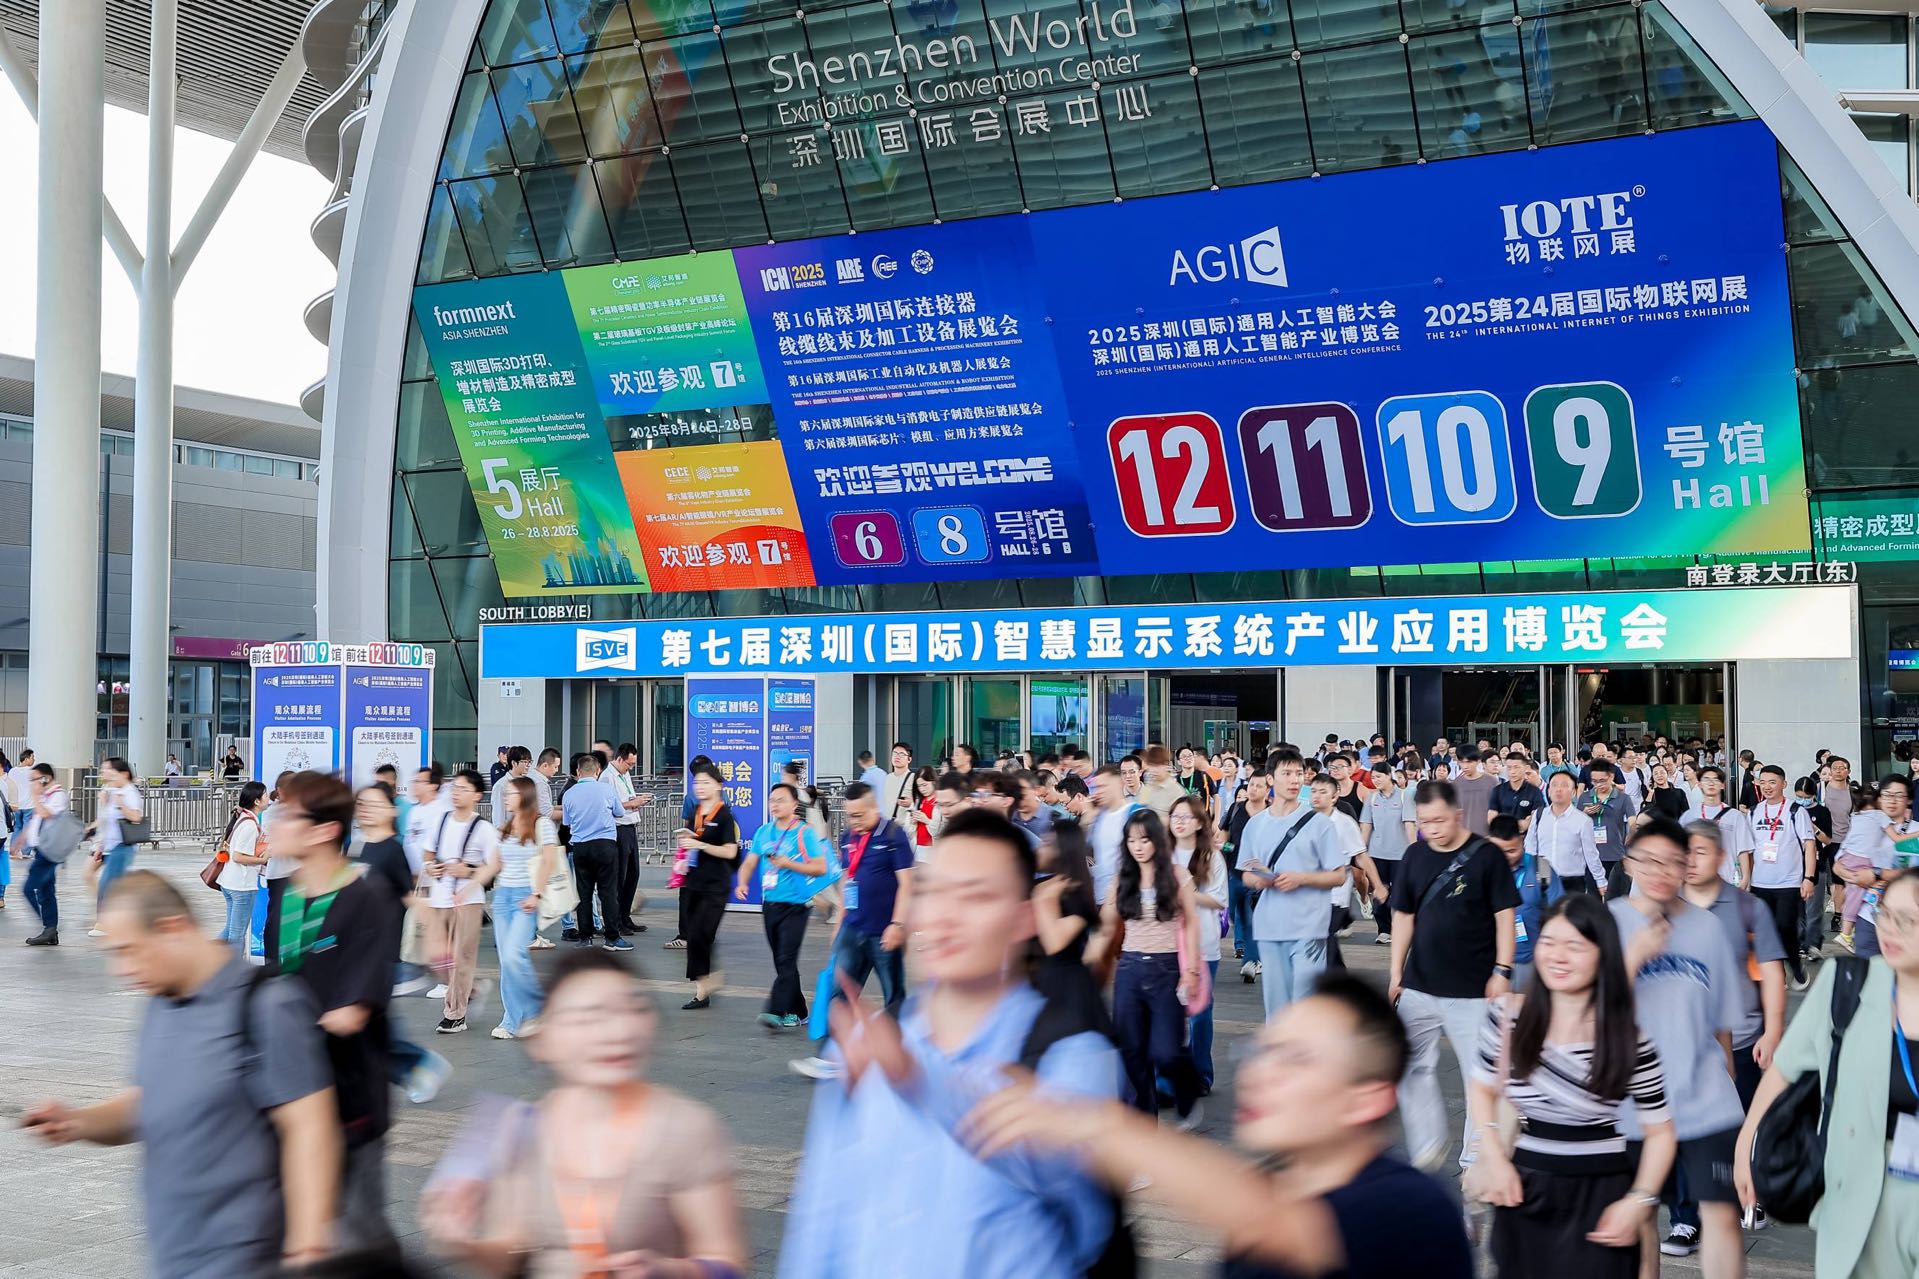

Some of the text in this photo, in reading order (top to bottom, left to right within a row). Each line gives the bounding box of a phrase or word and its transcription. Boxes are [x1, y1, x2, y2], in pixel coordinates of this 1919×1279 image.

[768, 1, 1137, 94] Shenzhen World
[777, 51, 1142, 127] Exhibition & Convention Center
[785, 85, 1151, 168] 深圳国际会展中心
[1499, 191, 1633, 241] IOTE
[1169, 225, 1288, 288] AGIC
[1506, 230, 1636, 265] 物联网展
[760, 267, 790, 292] ICH
[792, 264, 824, 281] 2025
[795, 280, 826, 288] SHENZHEN
[433, 300, 516, 326] formnext
[773, 291, 976, 333] 第16届深圳国际连接器
[1424, 275, 1747, 327] 2025第24届国际物联网展
[442, 325, 508, 341] ASIA SHENZHEN
[778, 314, 1019, 357] 线缆线束及加工设备展览会
[1088, 301, 1396, 345] 2025深圳(国际)通用人工智能大会
[1426, 332, 1445, 340] THE
[1475, 322, 1558, 336] INTERNATIONAL
[1563, 317, 1616, 329] INTERNET
[1621, 314, 1633, 323] OF
[1638, 311, 1679, 321] THINGS
[1684, 305, 1750, 318] EXHIBITION
[1092, 323, 1399, 366] 深圳(国际)通用人工智能产业博览会
[451, 353, 552, 376] 深圳国际3D打印、
[1154, 361, 1214, 372] (INTERNATIONAL)
[1218, 358, 1256, 366] ARTIFICIAL
[1295, 350, 1348, 359] INTELLIGENCE
[1351, 345, 1401, 354] CONFERENCE
[457, 370, 576, 395] 增材制造及精密成型
[609, 365, 705, 396] 欢迎参观
[716, 364, 728, 384] 7
[788, 356, 1011, 388] 第16届深圳国际工业自动化及机器人展览会
[463, 397, 501, 413] 展览会
[799, 402, 1043, 432] 第六届深圳国际家电与消费电子制造供应链展览会
[500, 415, 540, 425] International
[537, 422, 585, 432] Manufacturing
[629, 417, 752, 439] 2025年8月26日-28日
[548, 432, 590, 441] Technologies
[804, 424, 1023, 451] 第六届深圳国际芯片、模组、应用方案展览会
[665, 467, 689, 478] CECE
[1118, 397, 1765, 526] 12 11 10 9 号馆
[481, 458, 560, 519] 5 展厅
[1672, 474, 1769, 510] Hall
[527, 497, 564, 517] Hall
[502, 528, 515, 539] 26
[527, 525, 578, 538] 28.8.2025
[855, 508, 1068, 560] 6 8 号馆
[1815, 514, 1919, 538] 精密成型
[659, 542, 751, 568] 欢迎参观
[762, 544, 773, 561] 7
[1001, 541, 1072, 556] HALL 6 8
[1840, 543, 1885, 551] Advanced
[1685, 560, 1857, 587] 南登录大厅(东)
[479, 605, 591, 621] SOUTH LOBBY(E)
[660, 603, 1668, 668] 第七届深圳(国际)智慧显示系统产业应用博览会
[243, 643, 249, 656] 6
[251, 643, 342, 664] 前往 12 11 10 9 馆
[346, 645, 434, 664] 前往 12 11 10 9 馆
[586, 641, 626, 657] ISVE
[275, 705, 321, 714] 观众观展流程
[365, 706, 410, 715] 观众观展流程
